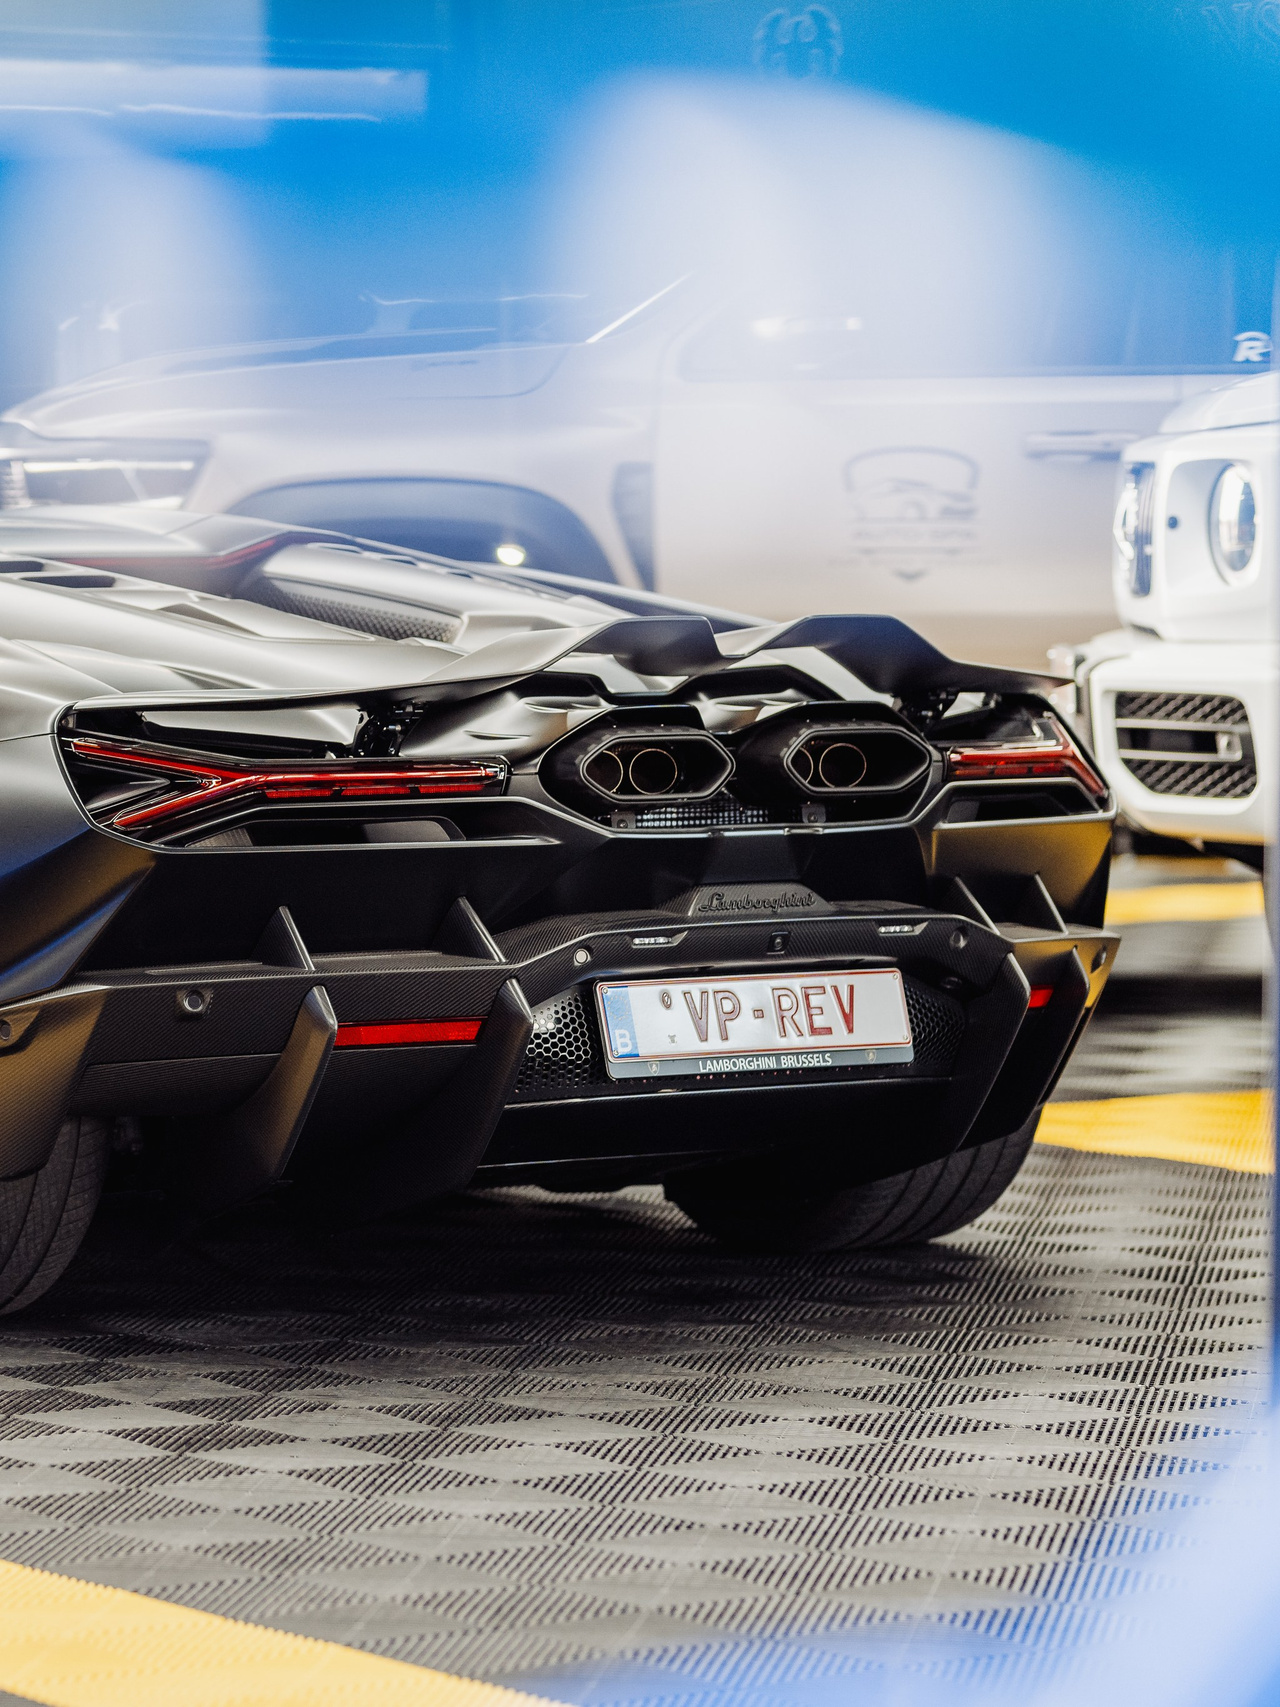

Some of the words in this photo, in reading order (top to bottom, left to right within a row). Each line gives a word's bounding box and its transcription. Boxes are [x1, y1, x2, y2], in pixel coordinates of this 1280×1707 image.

[698, 892, 816, 914] Lamborghini
[615, 1029, 632, 1053] B
[699, 1055, 777, 1073] LAMBORGHINI
[780, 1052, 832, 1068] BRUSSELS
